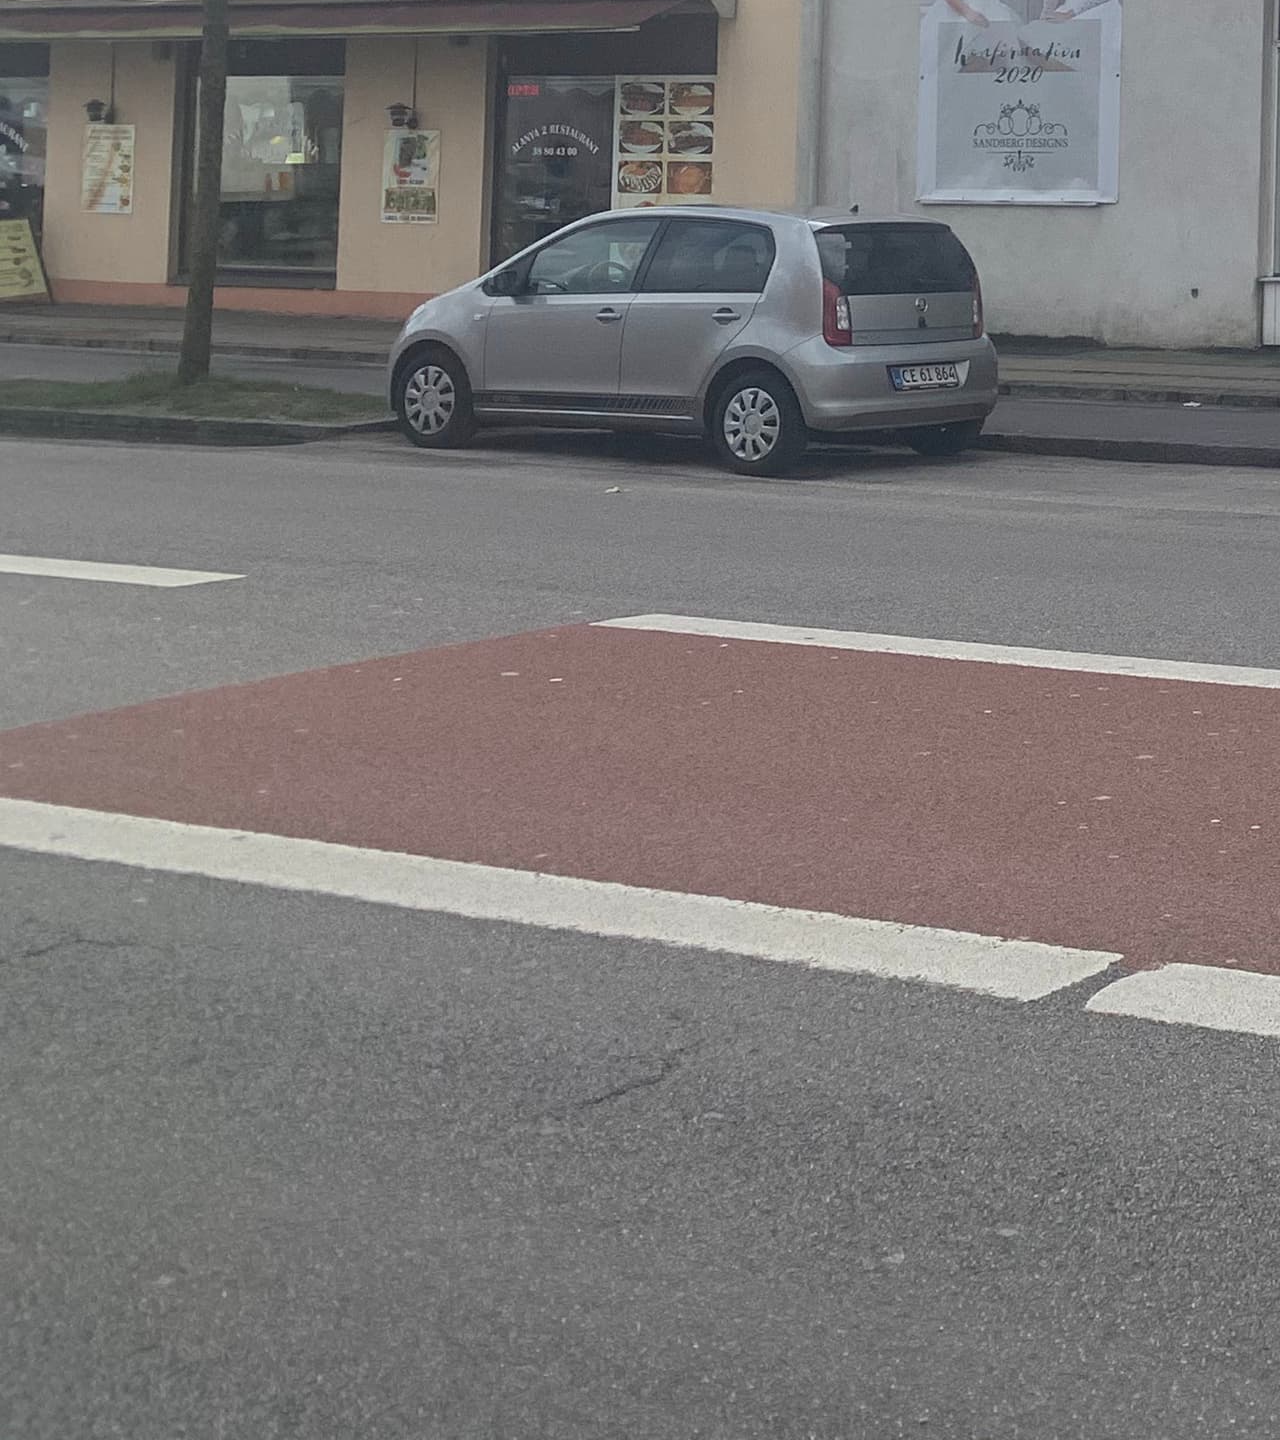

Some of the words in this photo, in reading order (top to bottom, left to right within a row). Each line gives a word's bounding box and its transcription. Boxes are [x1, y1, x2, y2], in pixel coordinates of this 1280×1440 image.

[994, 66, 1044, 84] 2020
[511, 128, 540, 155] ALANYA
[550, 124, 600, 155] RESTAURANT
[972, 138, 1024, 148] SANDBERG
[1025, 138, 1070, 148] DESIGNS
[902, 368, 918, 383] CE
[920, 367, 933, 381] 61
[935, 366, 955, 381] 864
